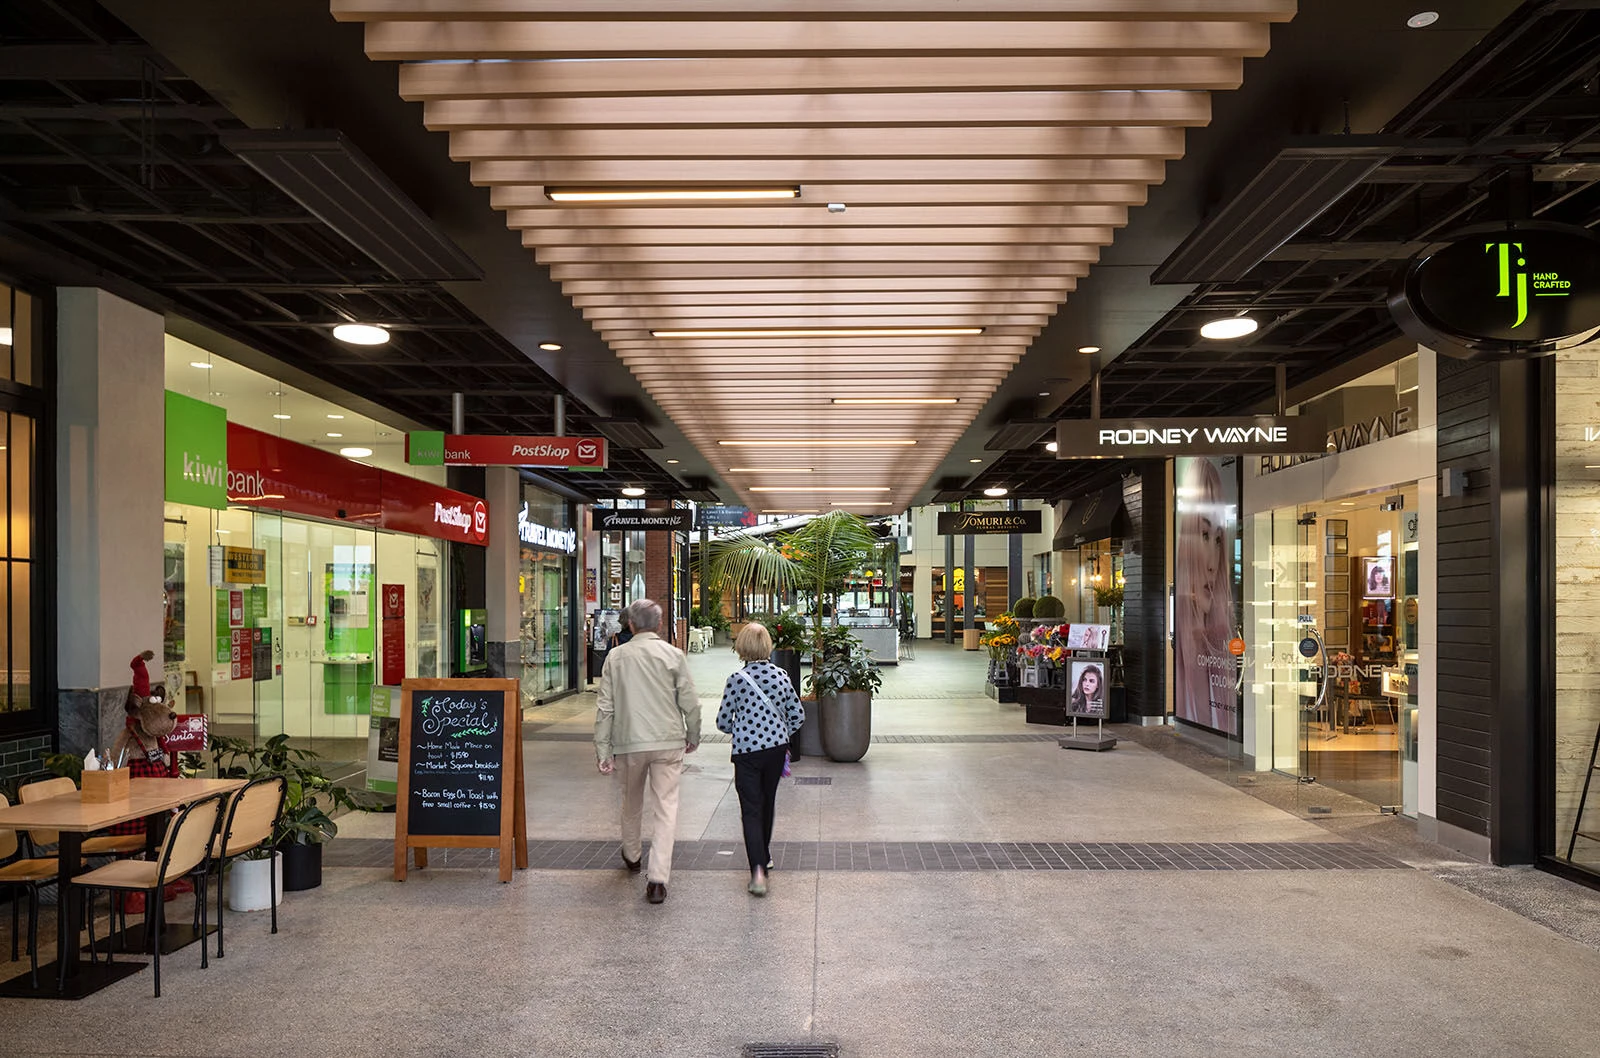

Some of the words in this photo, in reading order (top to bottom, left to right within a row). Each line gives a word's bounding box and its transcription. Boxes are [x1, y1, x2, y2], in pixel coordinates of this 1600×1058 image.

[1533, 272, 1558, 281] HAND
[1533, 280, 1571, 289] CRAFTED
[1099, 428, 1198, 445] RODNEY
[1203, 426, 1288, 443] WAYNE
[1333, 407, 1410, 454] WAYNE
[512, 444, 570, 460] PostShop
[434, 501, 472, 534] PostShop
[603, 512, 640, 526] TRAVEL
[954, 512, 1003, 530] TOMURI
[1004, 516, 1012, 525] &
[1299, 615, 1312, 623] PULL
[422, 705, 490, 737] Special
[422, 788, 440, 798] Bacon
[442, 789, 455, 800] Eggs
[456, 788, 466, 799] On
[467, 789, 484, 799] Toast
[437, 801, 453, 809] small
